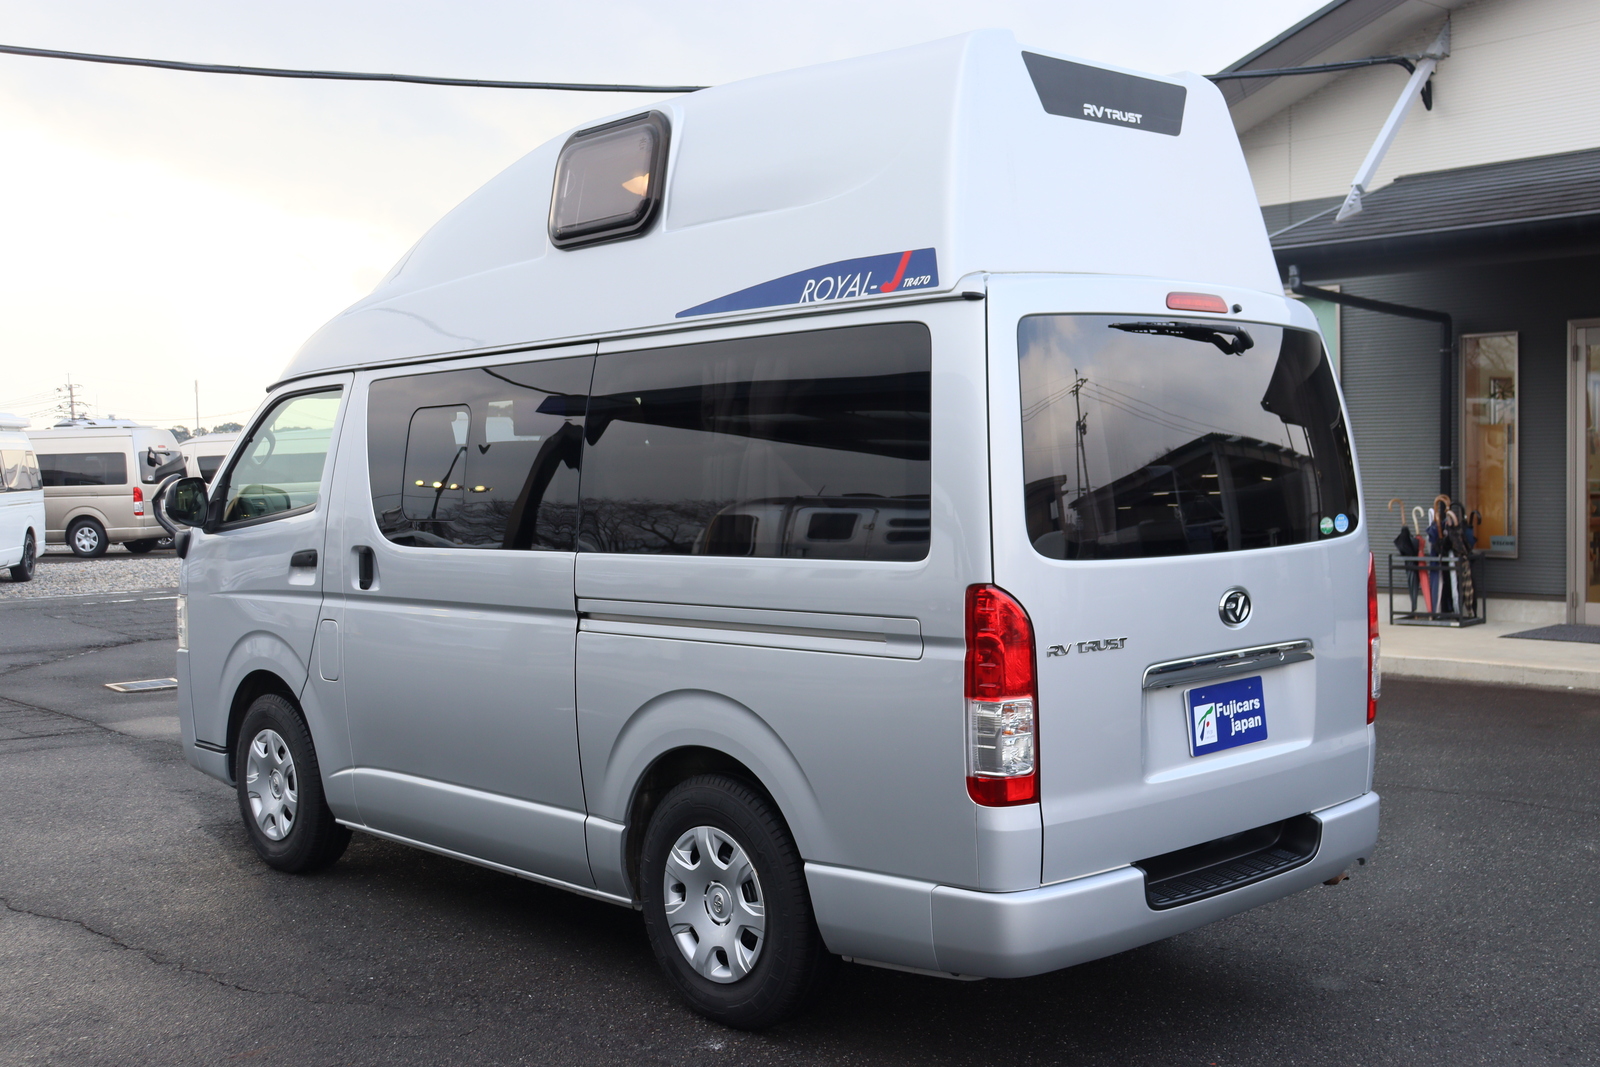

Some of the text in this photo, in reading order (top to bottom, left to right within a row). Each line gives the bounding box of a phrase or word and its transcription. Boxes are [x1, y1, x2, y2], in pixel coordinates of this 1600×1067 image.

[1083, 103, 1143, 124] RV TRUST
[902, 275, 931, 288] TR470
[1046, 636, 1128, 658] RV TRUST
[1216, 698, 1261, 718] Fujicars
[1231, 715, 1262, 736] japan
